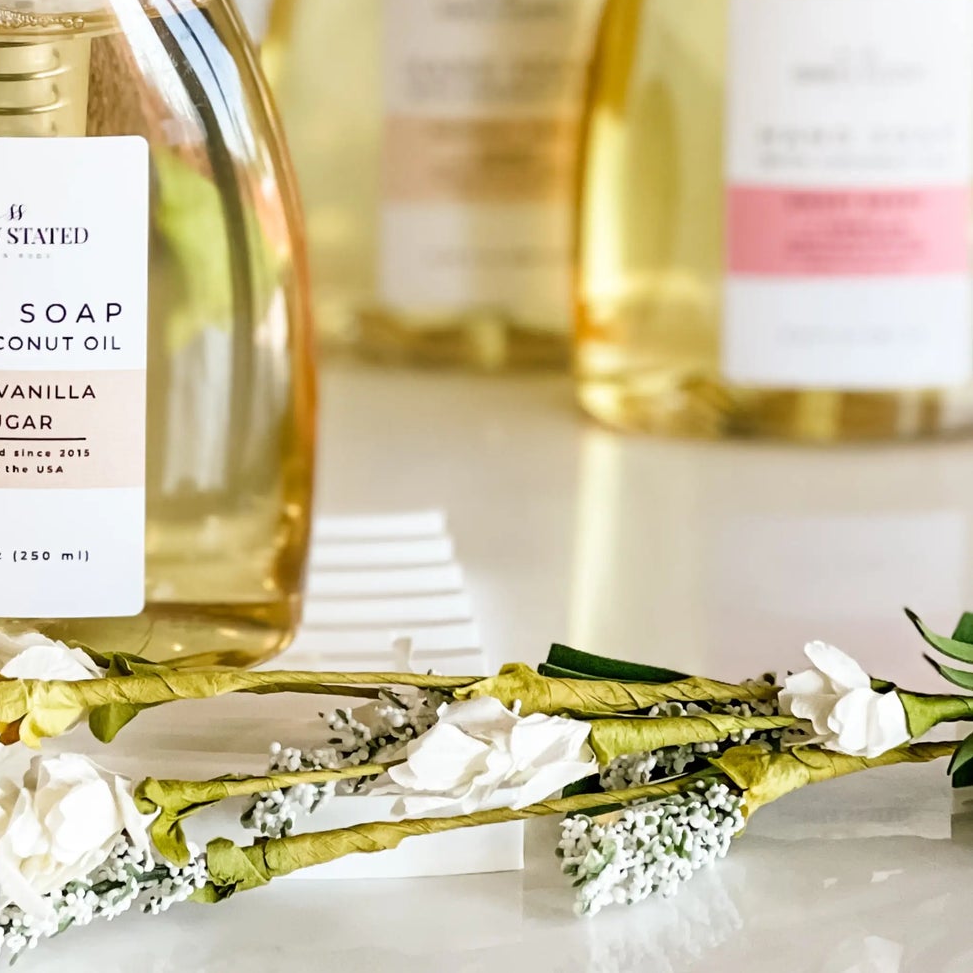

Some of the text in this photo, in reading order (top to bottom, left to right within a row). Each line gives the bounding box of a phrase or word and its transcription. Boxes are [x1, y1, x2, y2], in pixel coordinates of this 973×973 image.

[7, 227, 89, 245] STATED
[20, 302, 122, 324] SOAP
[84, 335, 121, 351] OIL
[13, 448, 52, 458] since
[59, 448, 90, 458] 2015
[5, 464, 29, 474] the
[36, 465, 64, 474] USA
[12, 549, 51, 563] (250
[61, 549, 90, 562] ml)
